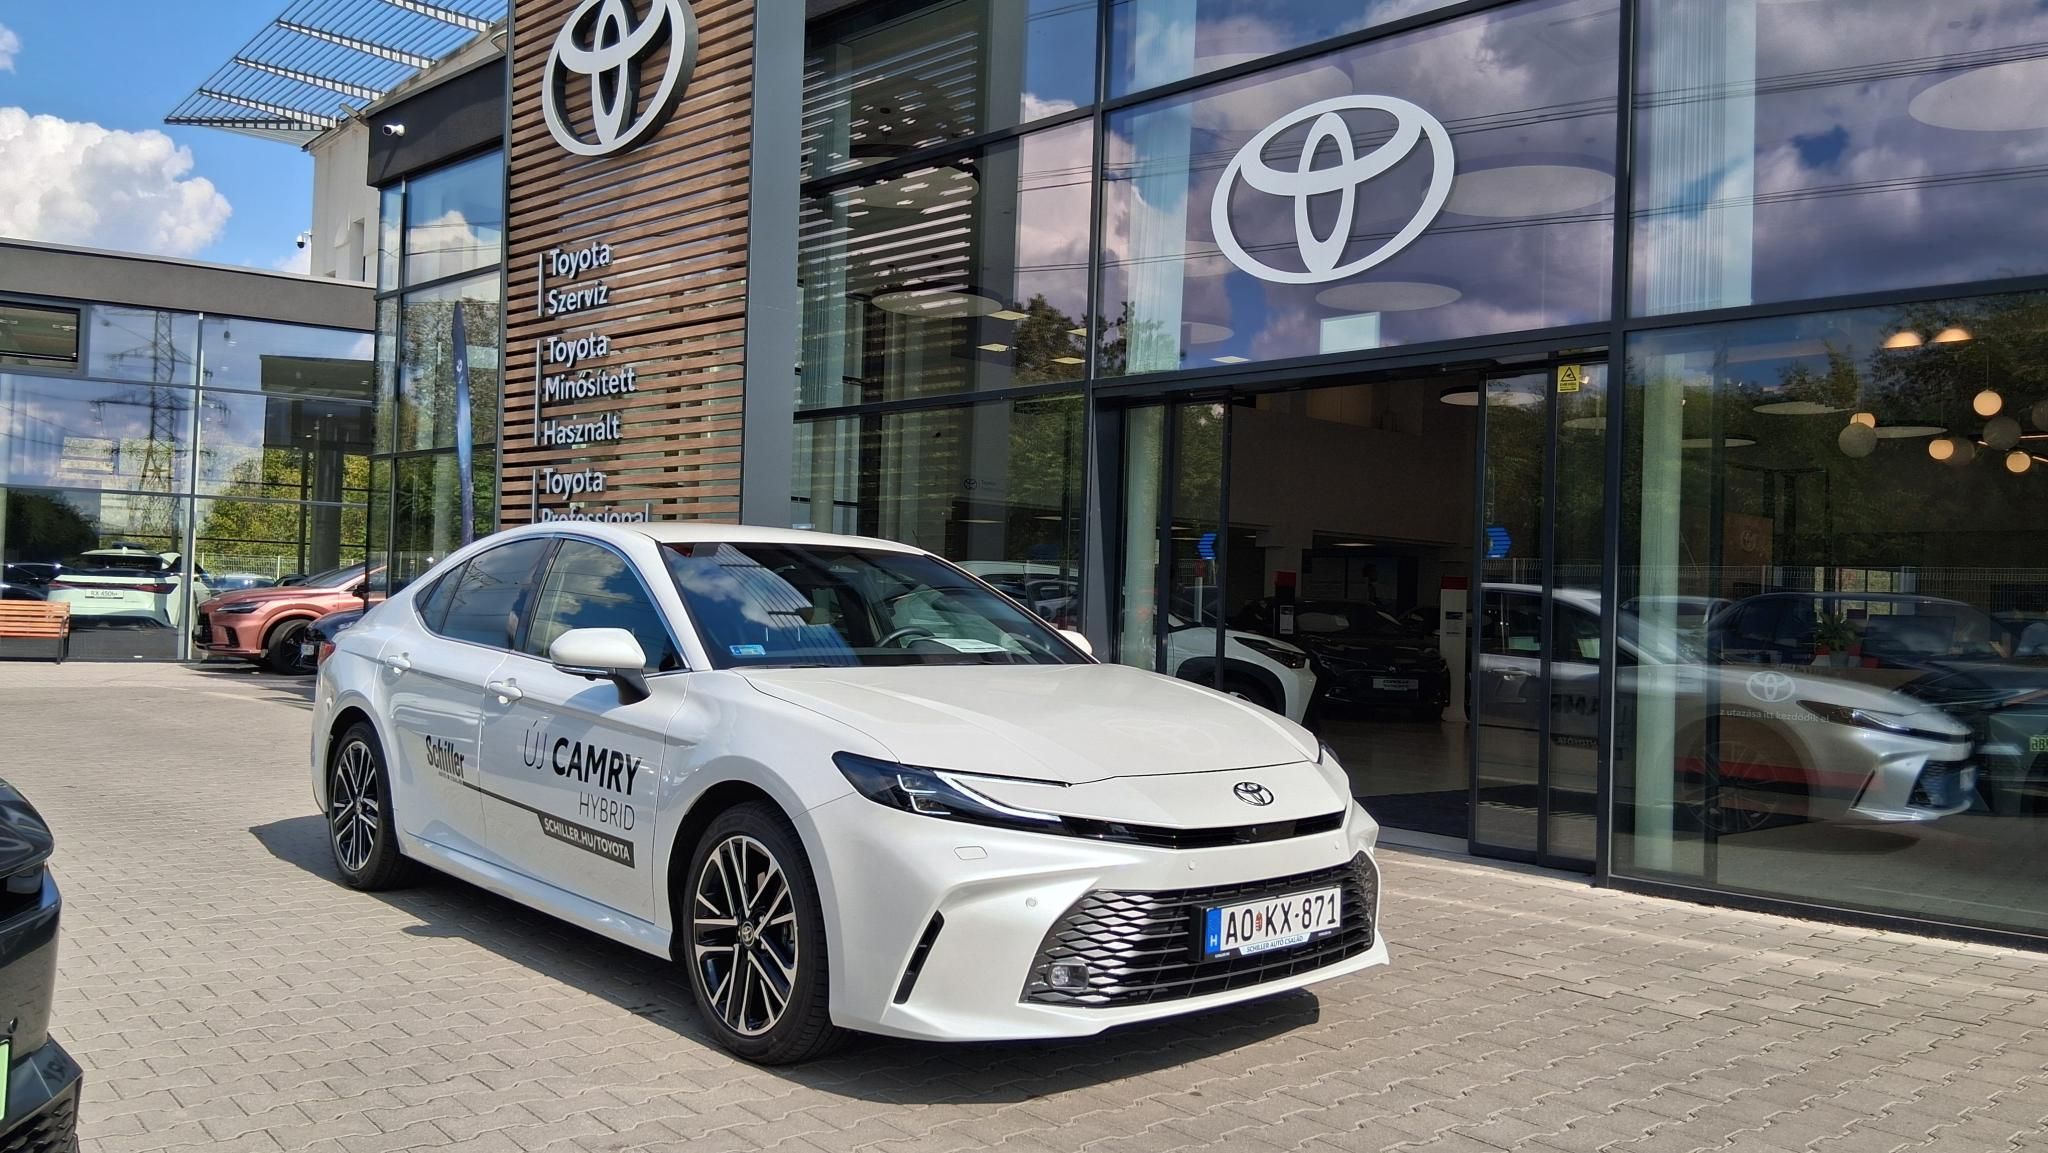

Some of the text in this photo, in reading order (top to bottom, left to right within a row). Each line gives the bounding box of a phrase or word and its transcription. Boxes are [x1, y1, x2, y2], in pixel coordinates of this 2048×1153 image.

[550, 242, 611, 279] Toyota
[548, 283, 608, 315] Szerviz
[547, 332, 608, 367] Toyota
[545, 367, 636, 401] Minősített
[543, 413, 620, 445] Használt
[543, 467, 604, 500] Toyota
[425, 734, 465, 779] Schiller
[523, 720, 641, 795] ÚJ CAMRY
[578, 792, 635, 831] HYBRID
[543, 817, 630, 861] SCHILLER.HU/TOYOTA
[1209, 934, 1218, 947] H
[1246, 942, 1270, 952] SCHILLER
